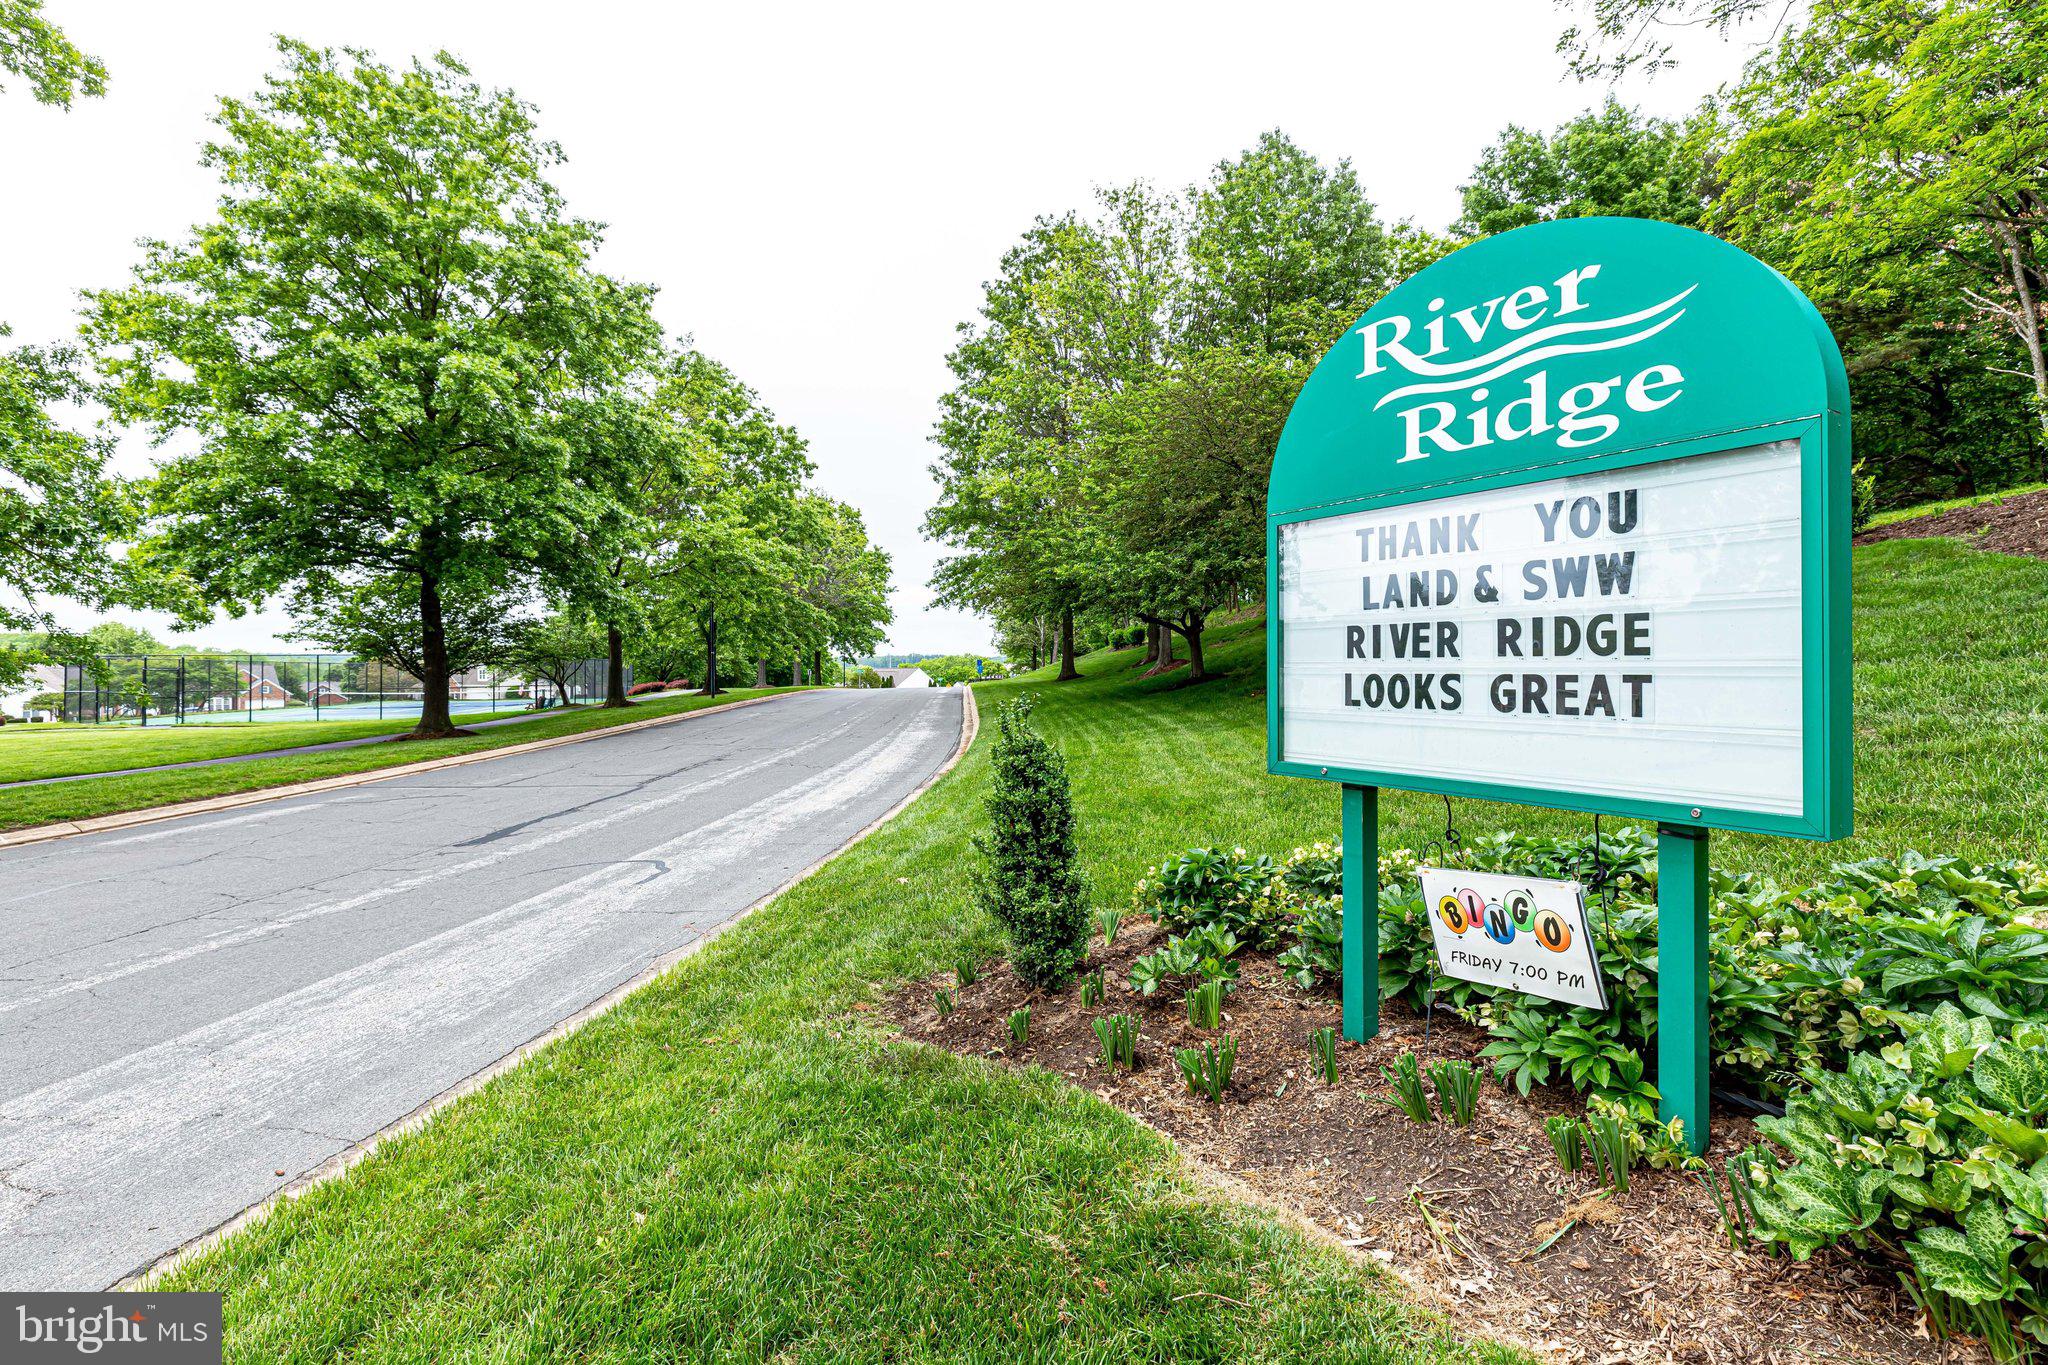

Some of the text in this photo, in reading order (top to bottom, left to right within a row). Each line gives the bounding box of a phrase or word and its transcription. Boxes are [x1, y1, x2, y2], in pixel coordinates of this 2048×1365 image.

[1355, 264, 1602, 379] River
[1396, 365, 1685, 464] Ridge
[1356, 488, 1638, 563] THANK YOU
[1362, 551, 1636, 611] LAND & SWW
[1346, 612, 1651, 659] RIVER RIDGE
[1344, 672, 1652, 718] LOOKS GREAT
[1445, 895, 1562, 946] BINGO
[1451, 951, 1585, 989] FRIDAY 7:00 PM
